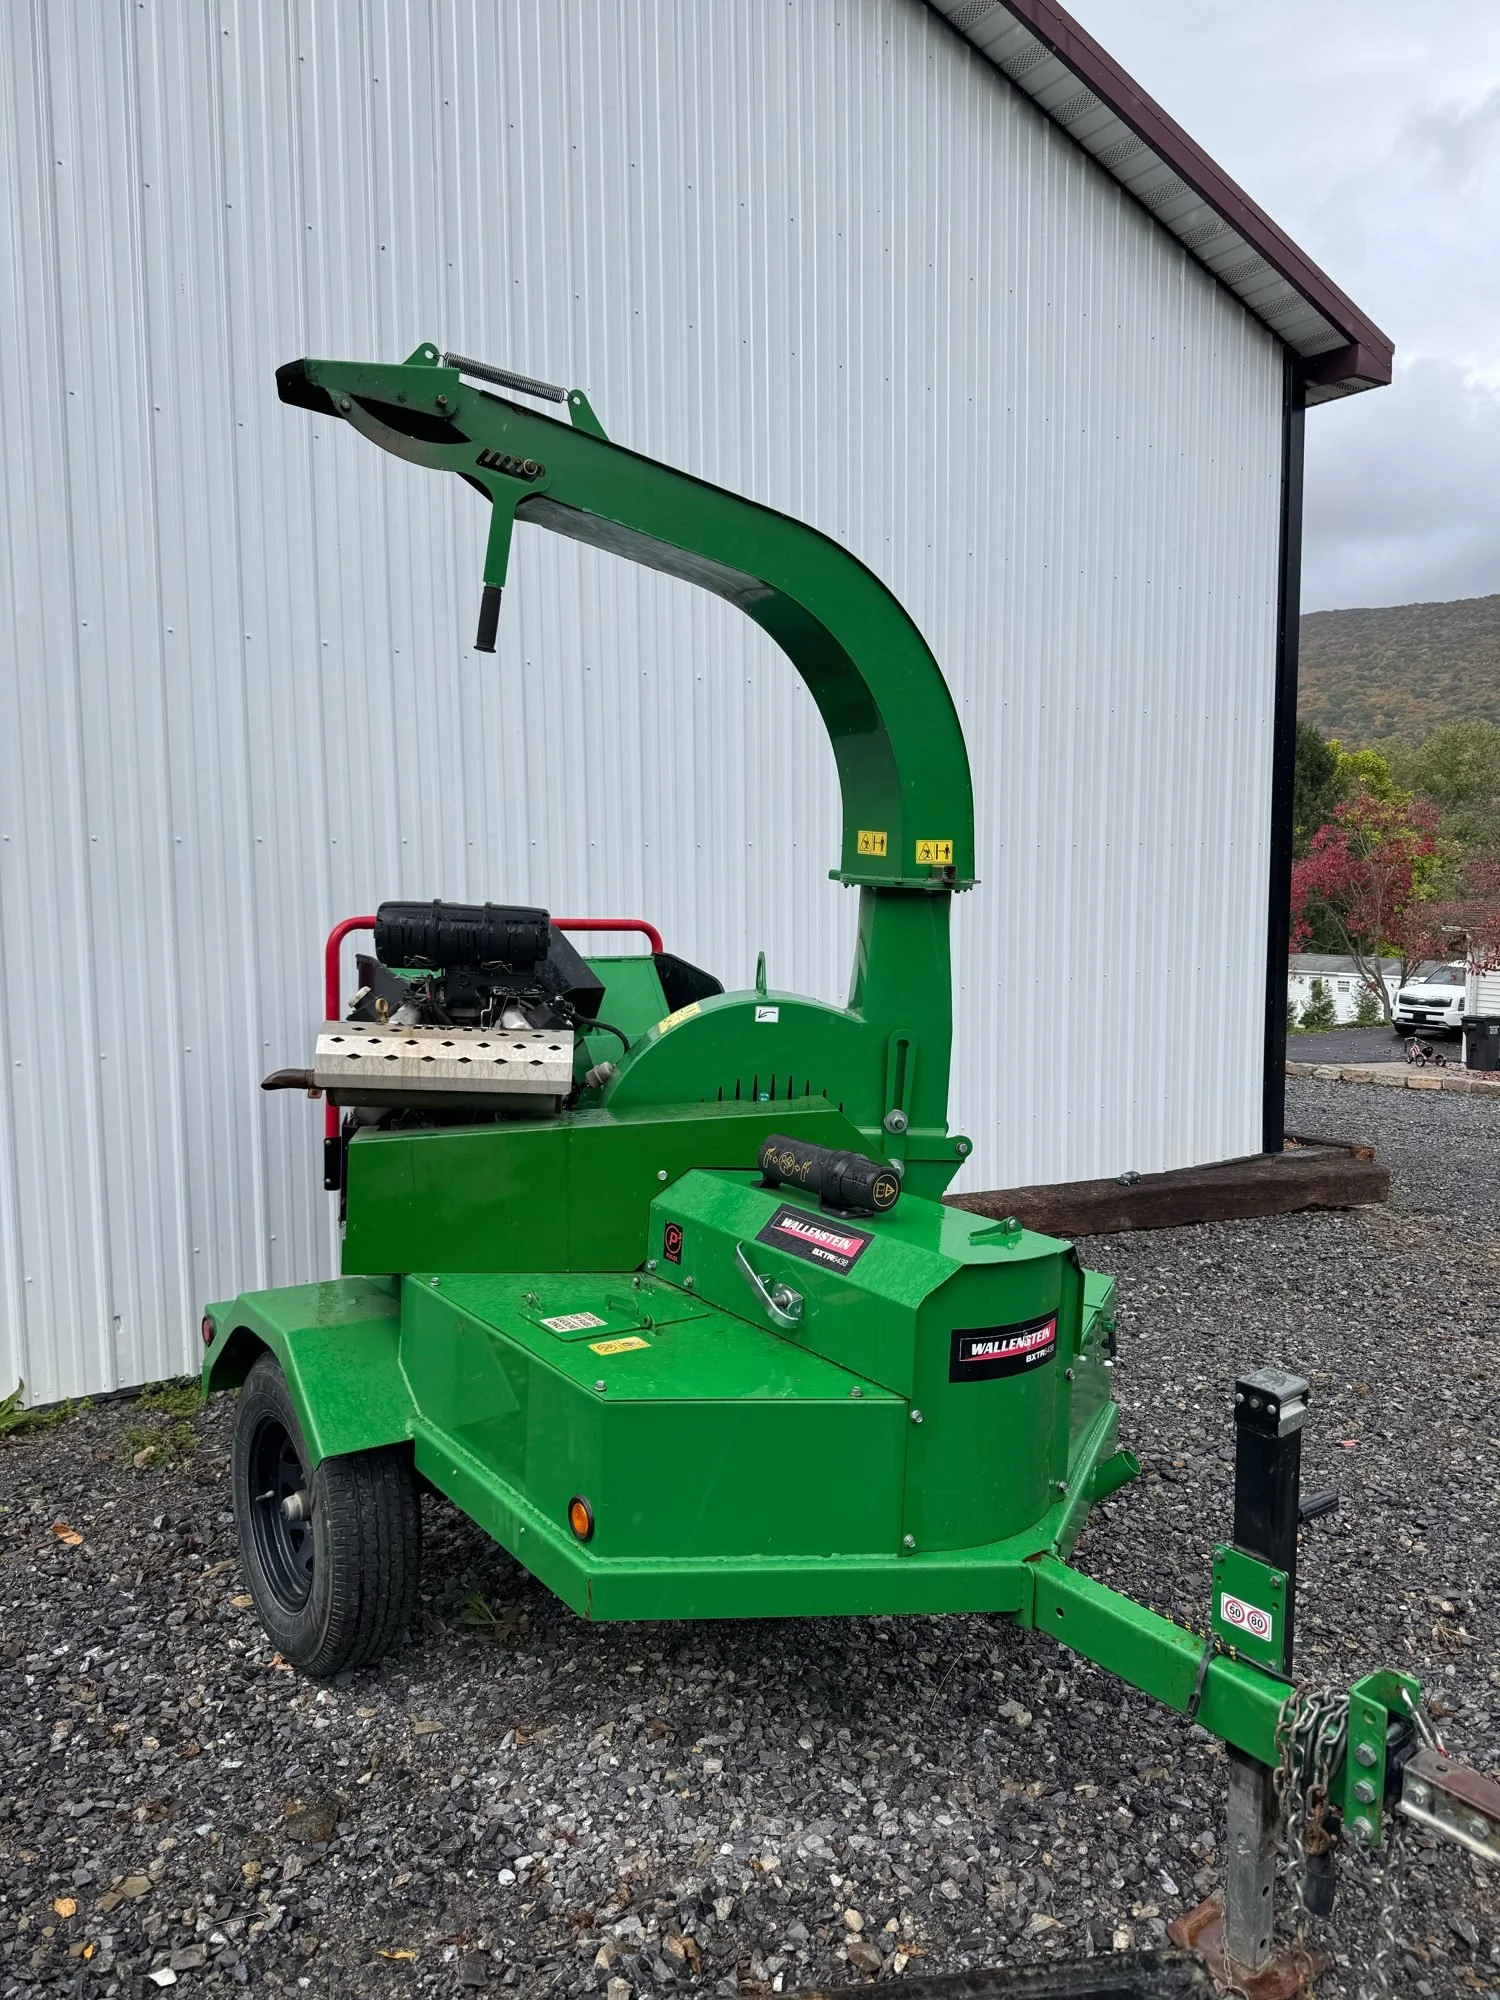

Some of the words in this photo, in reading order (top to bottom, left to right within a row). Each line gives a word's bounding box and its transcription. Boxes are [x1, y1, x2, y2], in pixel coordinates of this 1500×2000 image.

[781, 1217, 853, 1250] WALLENSTEIN
[811, 1247, 849, 1267] BXTR6438
[971, 1327, 1051, 1356] WALLENSTEIN
[1229, 1605, 1241, 1618] 50
[1251, 1616, 1263, 1629] 80
